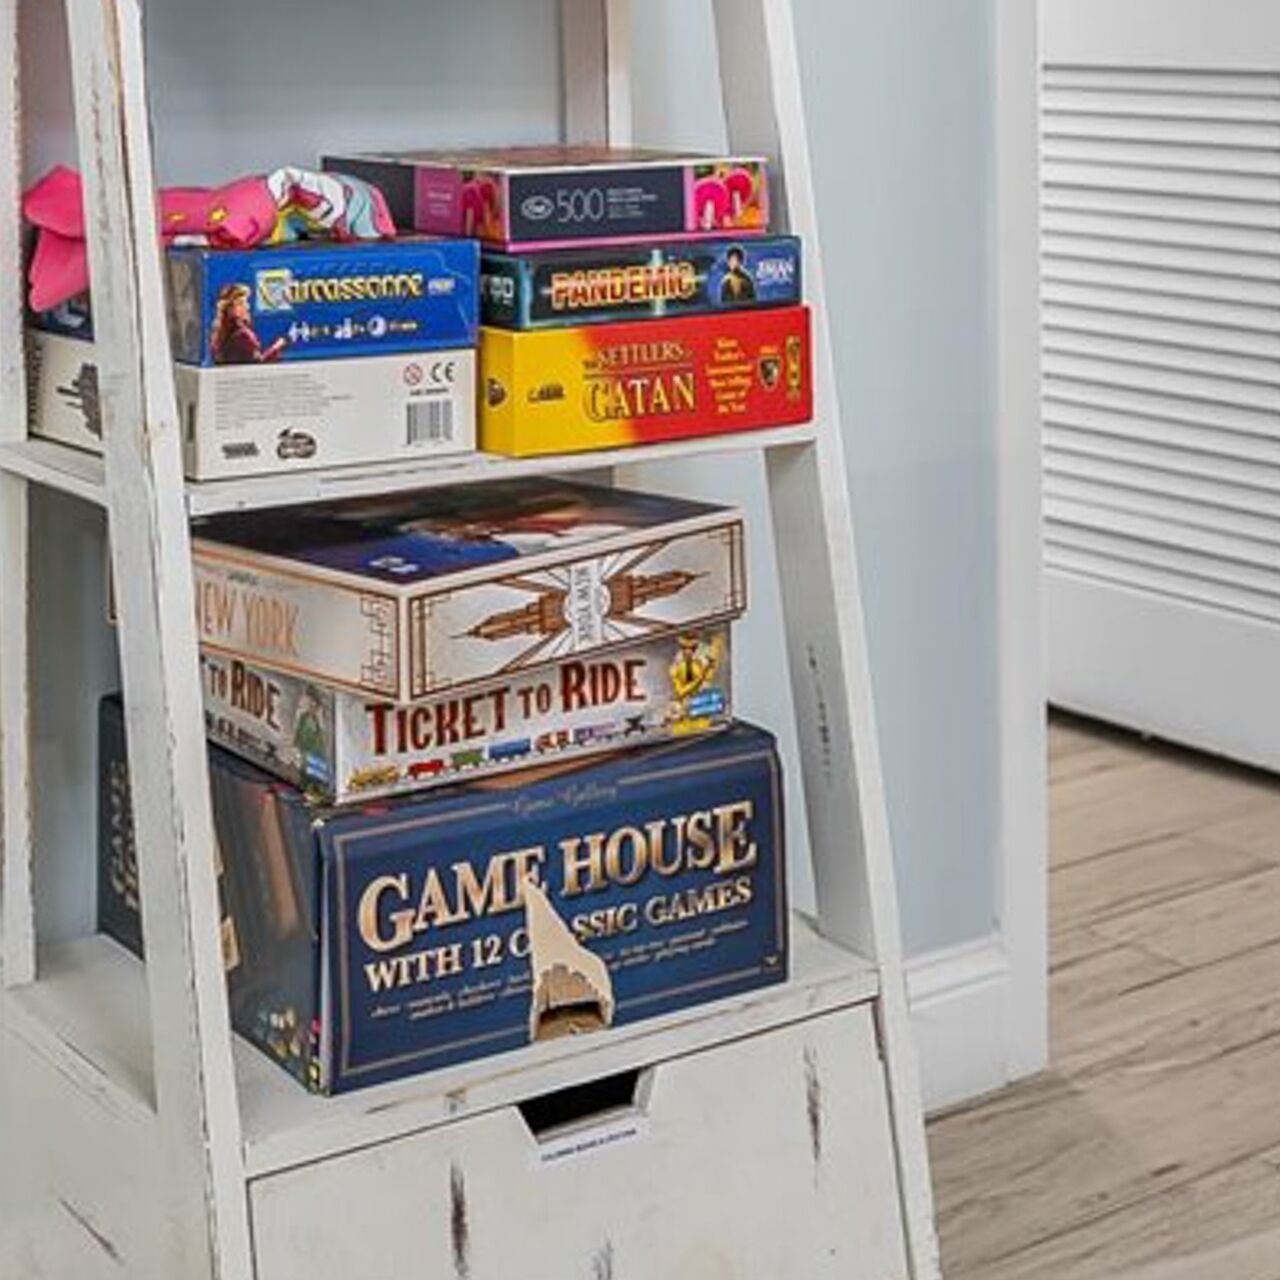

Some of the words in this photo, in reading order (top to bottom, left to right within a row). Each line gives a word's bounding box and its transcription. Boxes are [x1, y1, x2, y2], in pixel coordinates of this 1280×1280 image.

[555, 187, 605, 223] 500
[255, 268, 423, 311] Carcassonne
[550, 263, 697, 310] PANDEMIC
[595, 340, 685, 368] SETTLERS
[583, 373, 696, 423] CATAN
[243, 590, 300, 657] YORK
[230, 659, 281, 731] RIDE
[364, 685, 510, 756] TICKET
[517, 680, 553, 719] TO
[559, 659, 647, 713] RIDE
[357, 845, 548, 953] GAME
[558, 800, 758, 897] HOUSE
[363, 942, 463, 993] WITH
[472, 934, 504, 969] 12
[509, 903, 638, 958] CSSIC
[644, 875, 753, 926] GAMES
